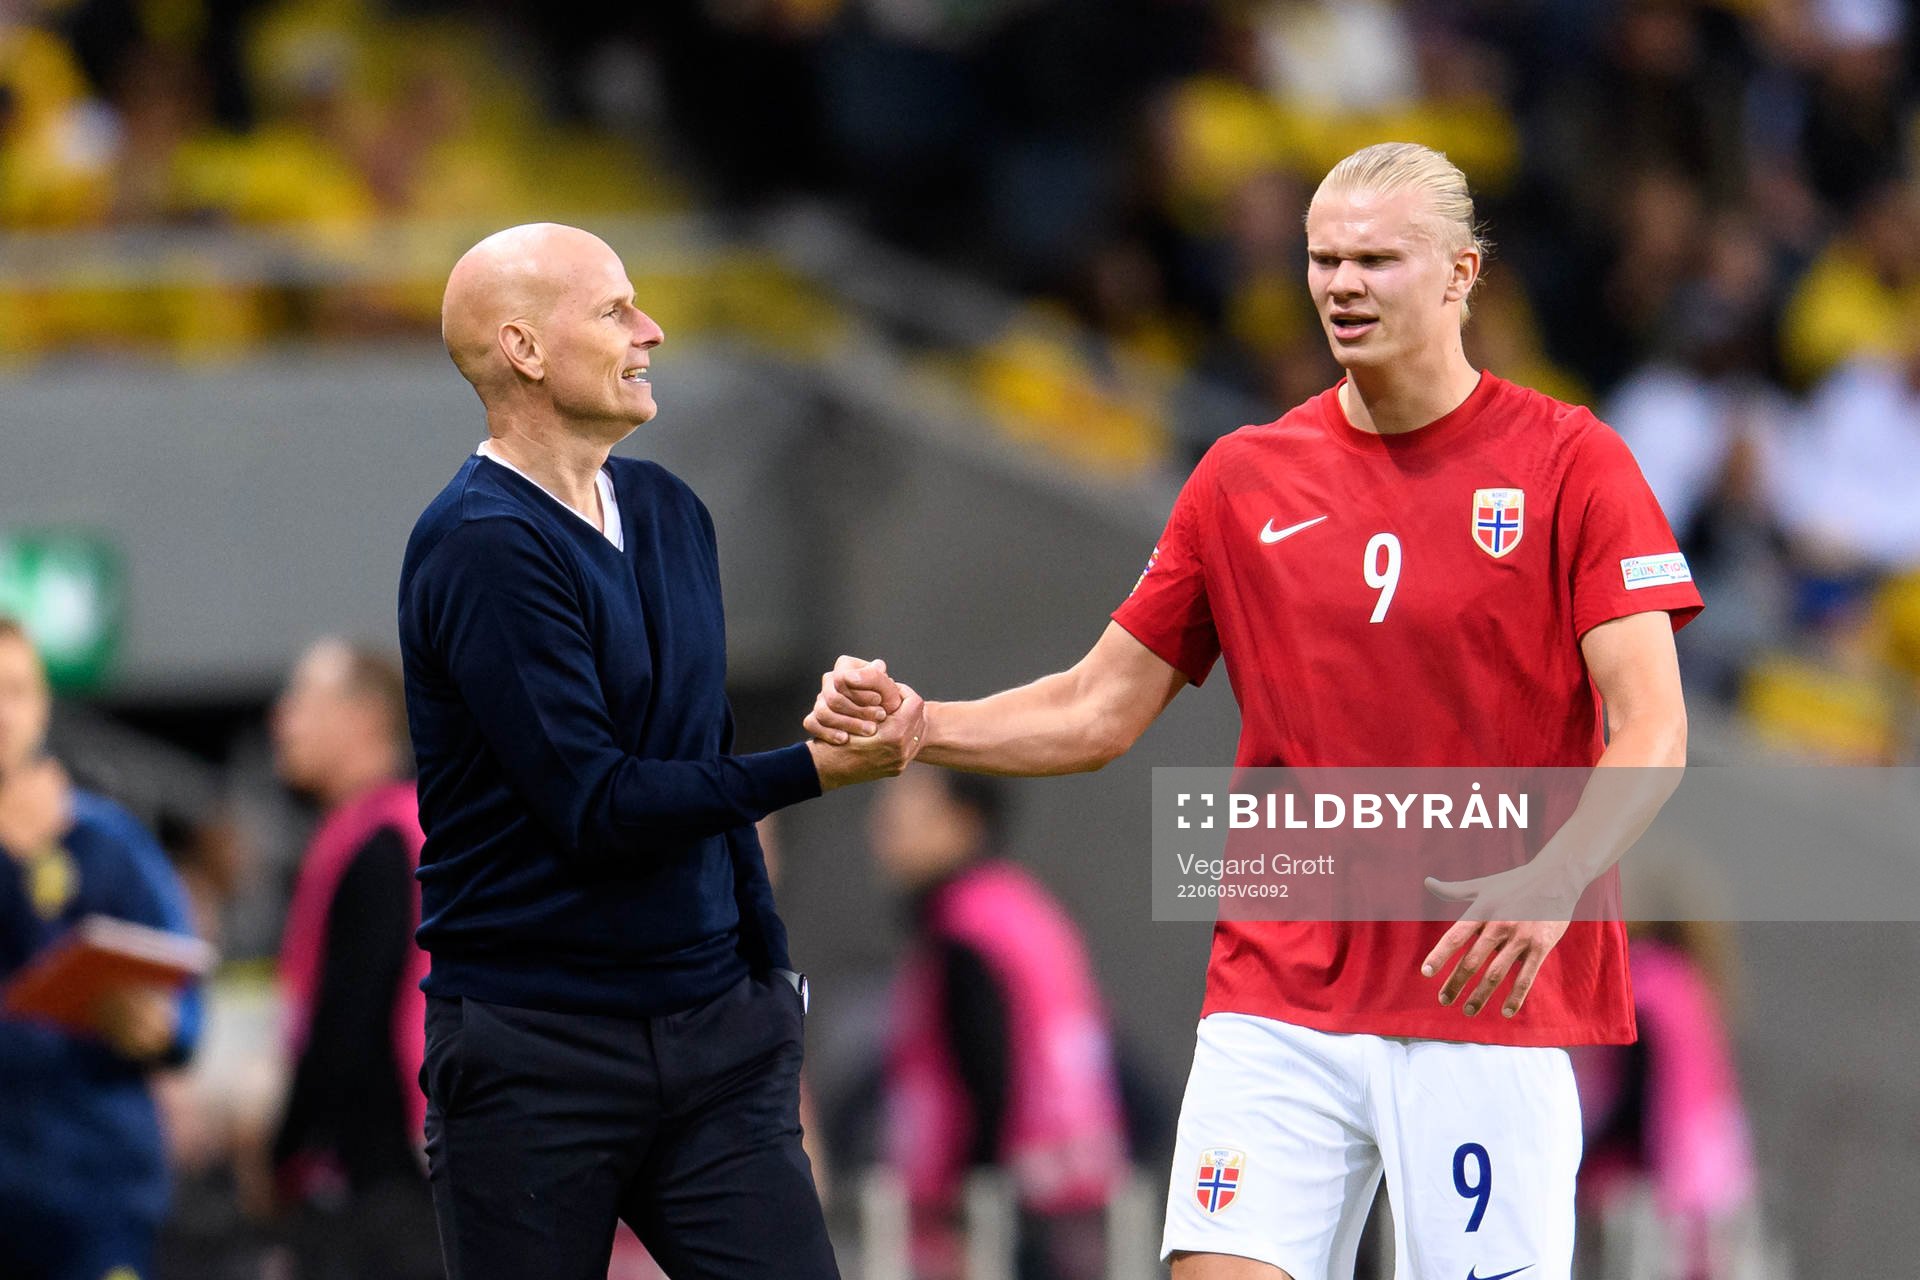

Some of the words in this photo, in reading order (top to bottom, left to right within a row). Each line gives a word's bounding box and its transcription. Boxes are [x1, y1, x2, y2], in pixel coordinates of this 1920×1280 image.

[1363, 532, 1402, 624] 9
[1625, 562, 1688, 579] FOUNATION
[1452, 1142, 1492, 1233] 9
